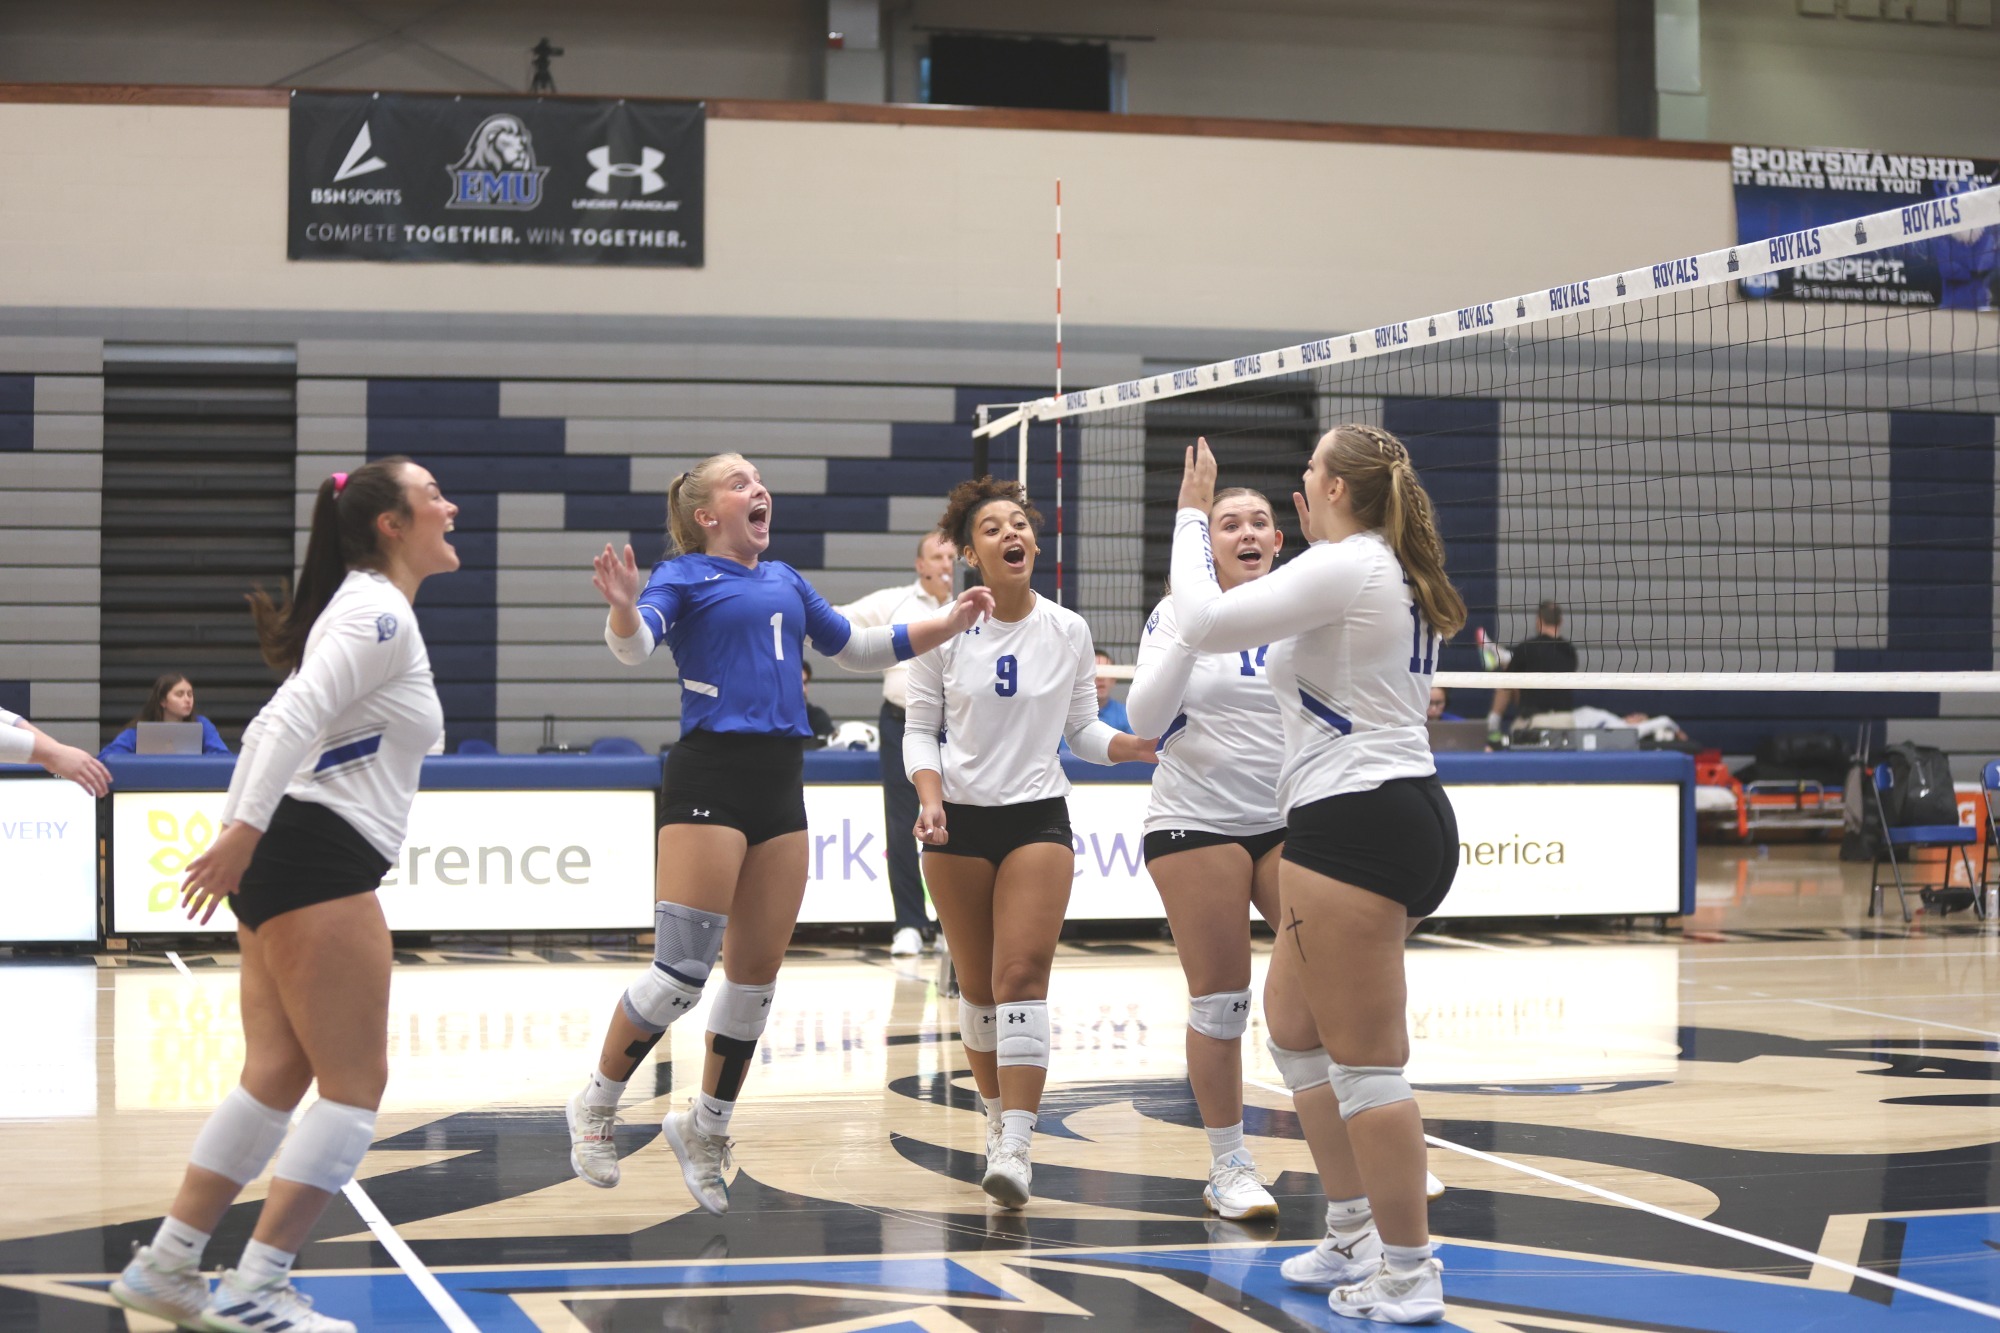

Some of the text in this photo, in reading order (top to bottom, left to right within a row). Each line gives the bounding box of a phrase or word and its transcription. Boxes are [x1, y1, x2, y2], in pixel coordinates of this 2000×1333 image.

[1731, 147, 1992, 184] SPORTSMANSHIP...
[1733, 170, 1921, 195] IT STARTS WITH YOU!
[456, 170, 540, 204] EMU
[305, 223, 687, 248] COMPETE TOGETHER. WIN TOGETHER.
[1173, 370, 1198, 390] ROYALS
[1234, 355, 1262, 378] ROYALS
[1301, 340, 1331, 364] ROYALS
[1374, 323, 1408, 348] ROYALS
[1457, 304, 1494, 331] ROYALS
[1549, 281, 1590, 312] ROYALS
[1652, 256, 1699, 289] ROYALS
[1768, 229, 1822, 264] ROYALS
[1901, 198, 1961, 235] ROYALS
[769, 612, 785, 661] 1
[994, 655, 1018, 698] 9
[2, 821, 69, 840] VERY
[807, 818, 878, 881] rk
